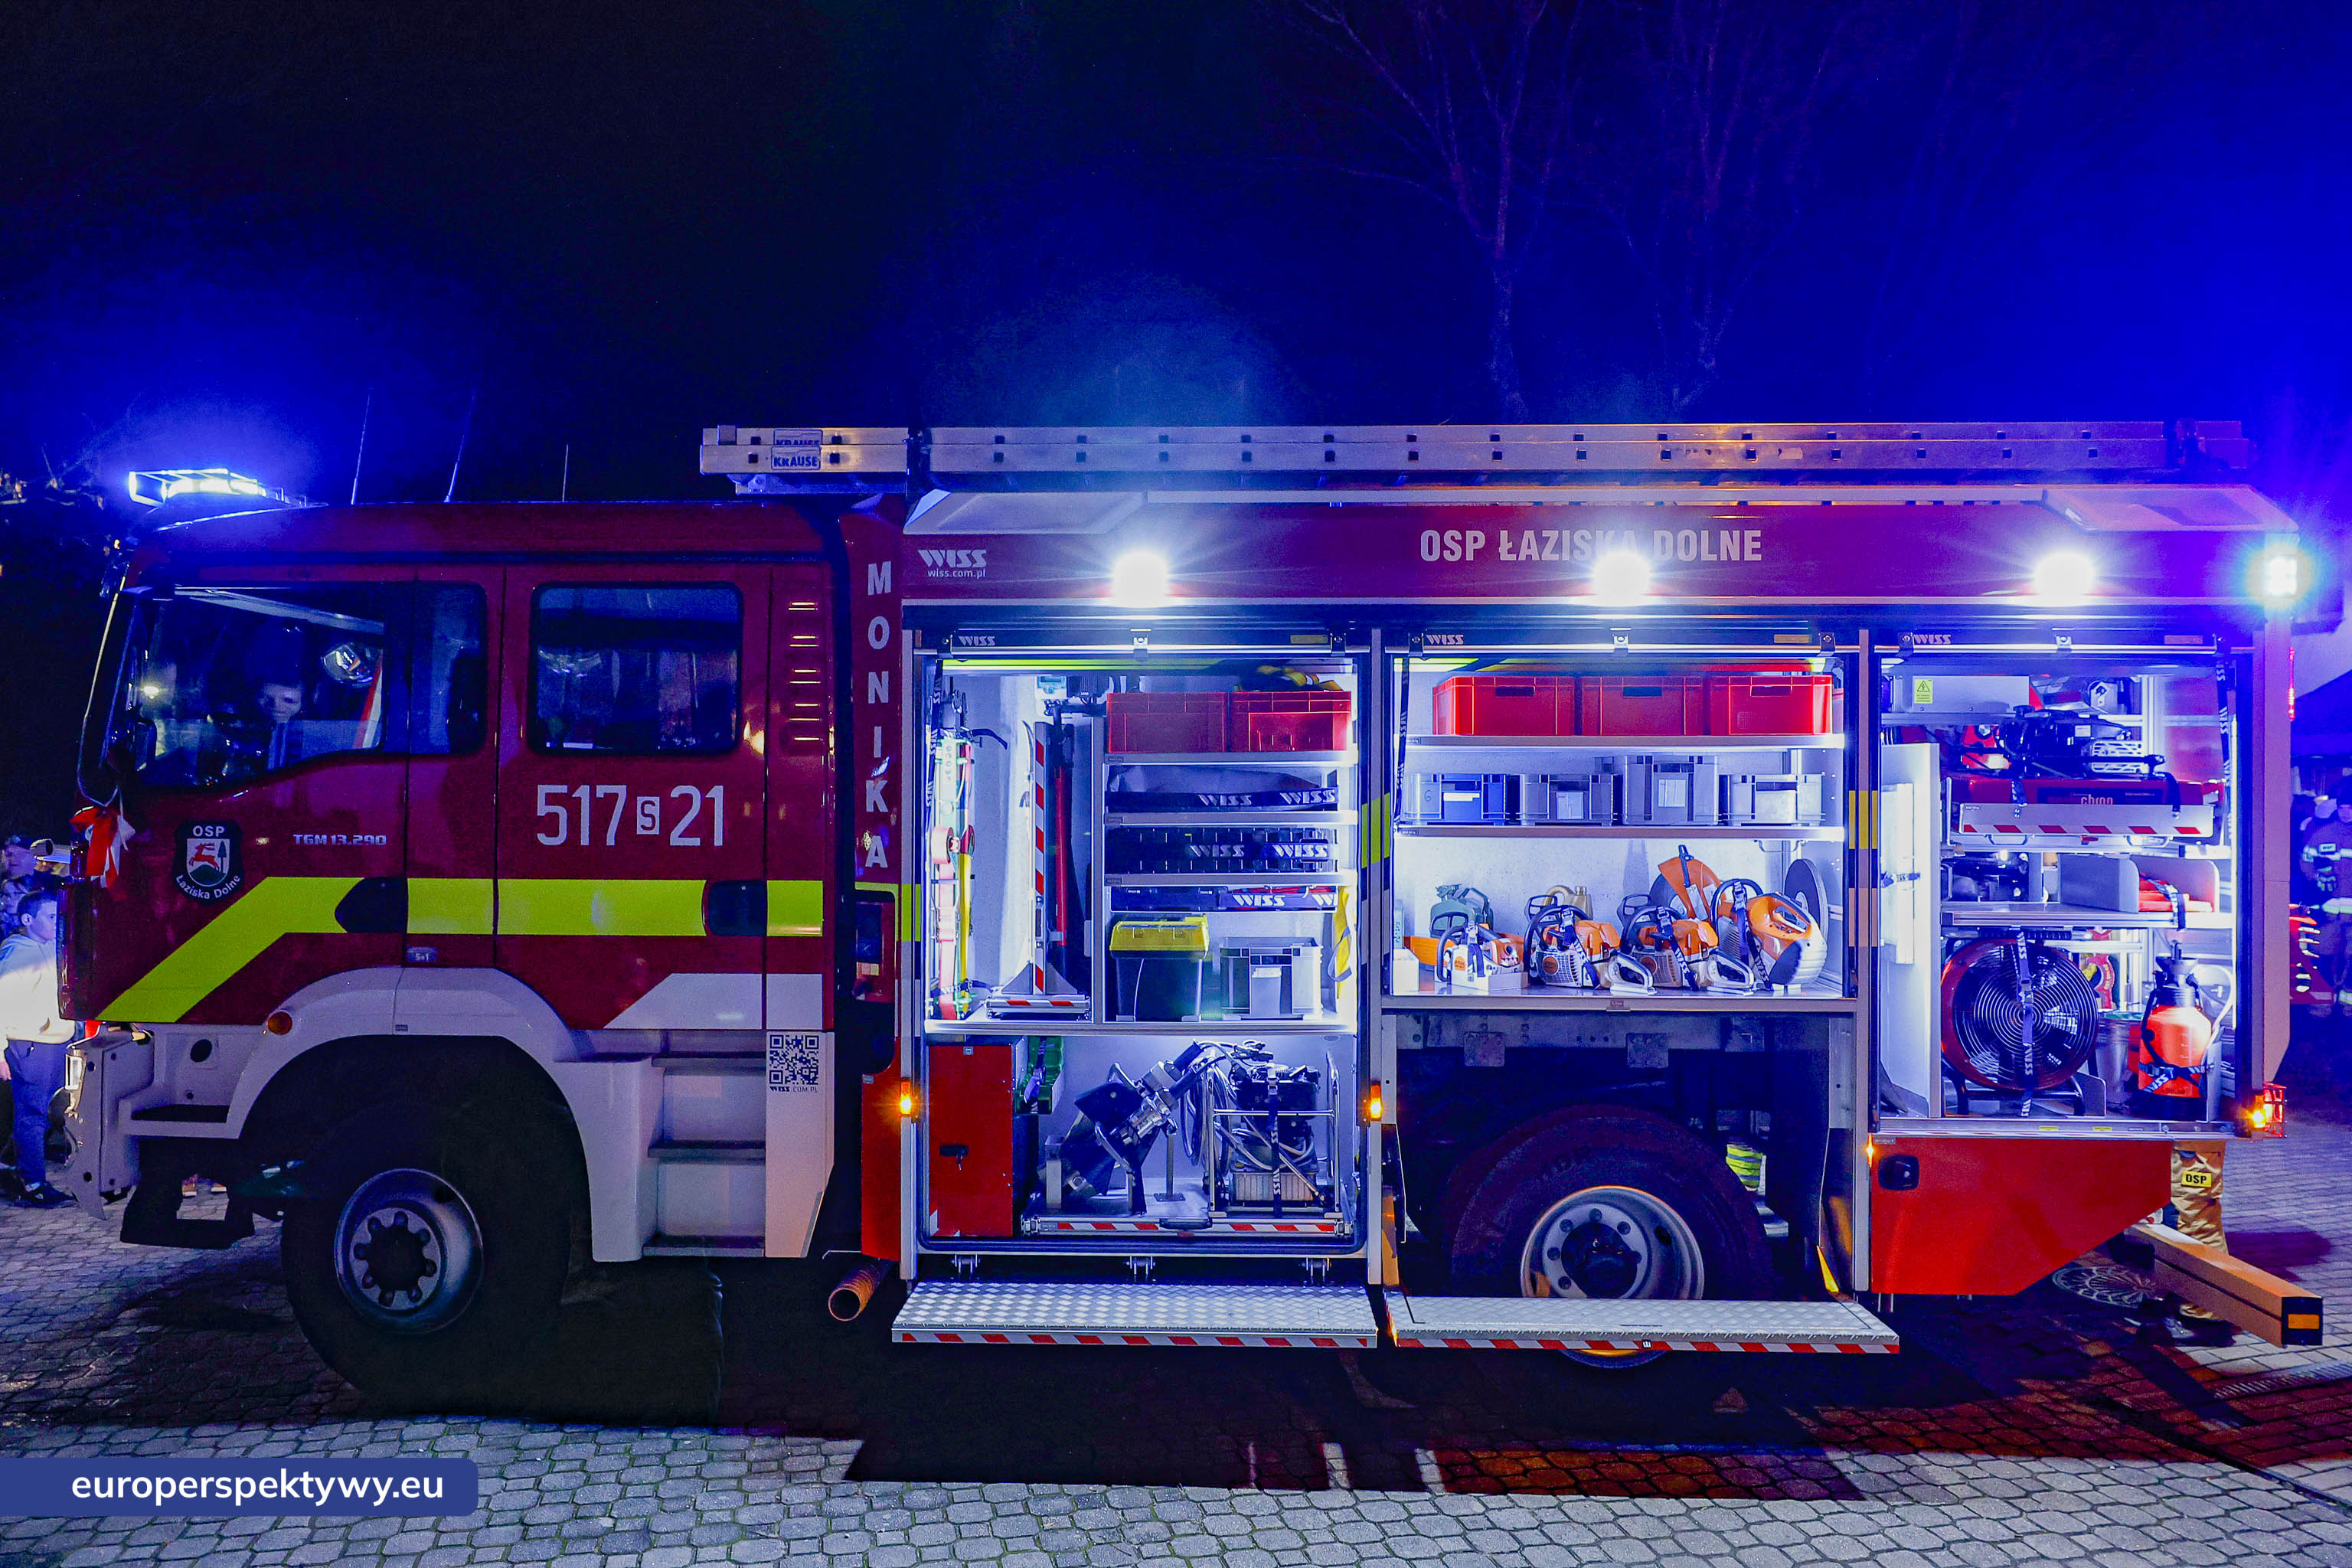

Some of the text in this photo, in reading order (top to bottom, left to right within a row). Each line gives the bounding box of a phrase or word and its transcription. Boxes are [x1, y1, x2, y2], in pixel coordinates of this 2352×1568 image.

[773, 456, 818, 467] KRAUSE
[1420, 530, 1485, 561] OSP
[1653, 530, 1762, 561] DOLNE
[918, 550, 987, 568] WISS
[927, 568, 986, 580] wiss.com.pl
[959, 635, 995, 645] WISS
[1426, 634, 1464, 645] WISS
[1913, 634, 1952, 644] WISS
[1197, 789, 1337, 806] WISS WISS
[537, 785, 724, 846] 517 S 21
[192, 825, 225, 838] OSP
[292, 834, 387, 846] TGM 13.290
[1190, 844, 1328, 858] WISS WISS
[175, 874, 241, 900] Łaziska Dolne
[1232, 894, 1286, 906] WISS
[1272, 1168, 1282, 1195] WISS
[2185, 1174, 2207, 1184] OSP
